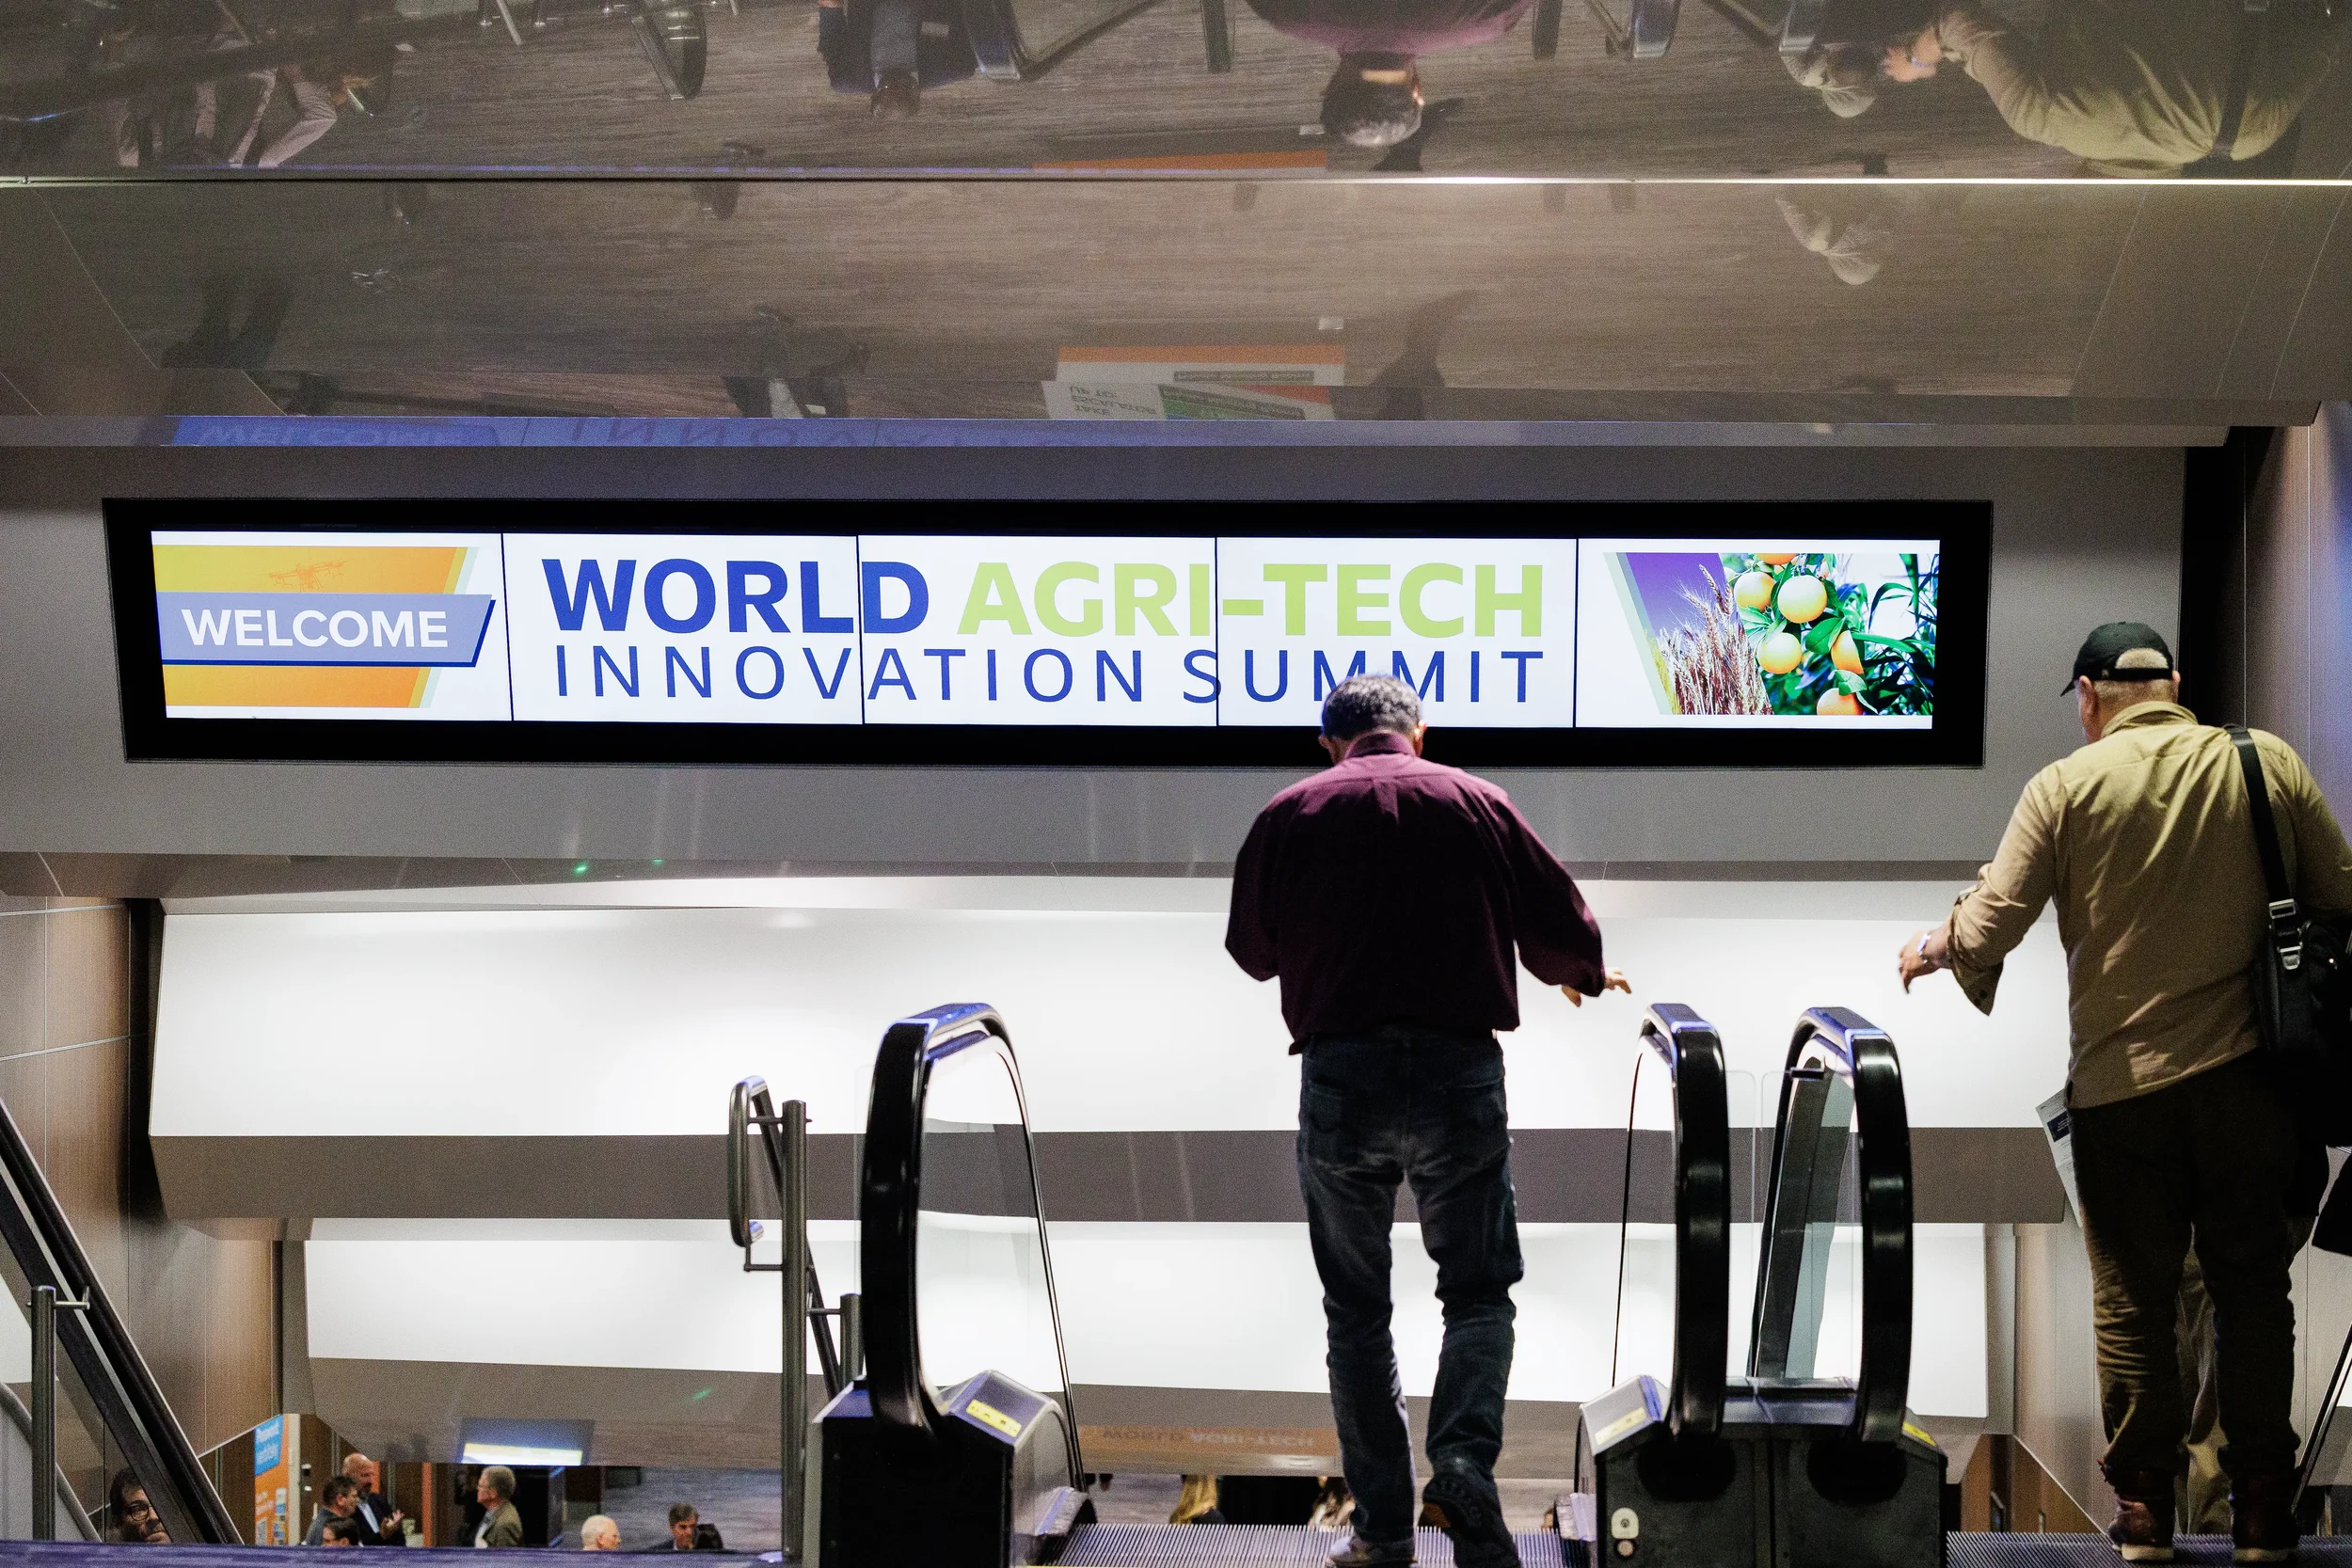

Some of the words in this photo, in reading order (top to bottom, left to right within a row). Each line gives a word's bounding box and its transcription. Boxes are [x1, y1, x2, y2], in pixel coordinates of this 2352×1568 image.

[542, 559, 930, 634] WORLD
[957, 562, 1543, 638] AGRI-TECH
[182, 610, 449, 647] WELCOME
[556, 645, 1142, 703] INNOVATION
[1183, 649, 1544, 703] SUMMIT
